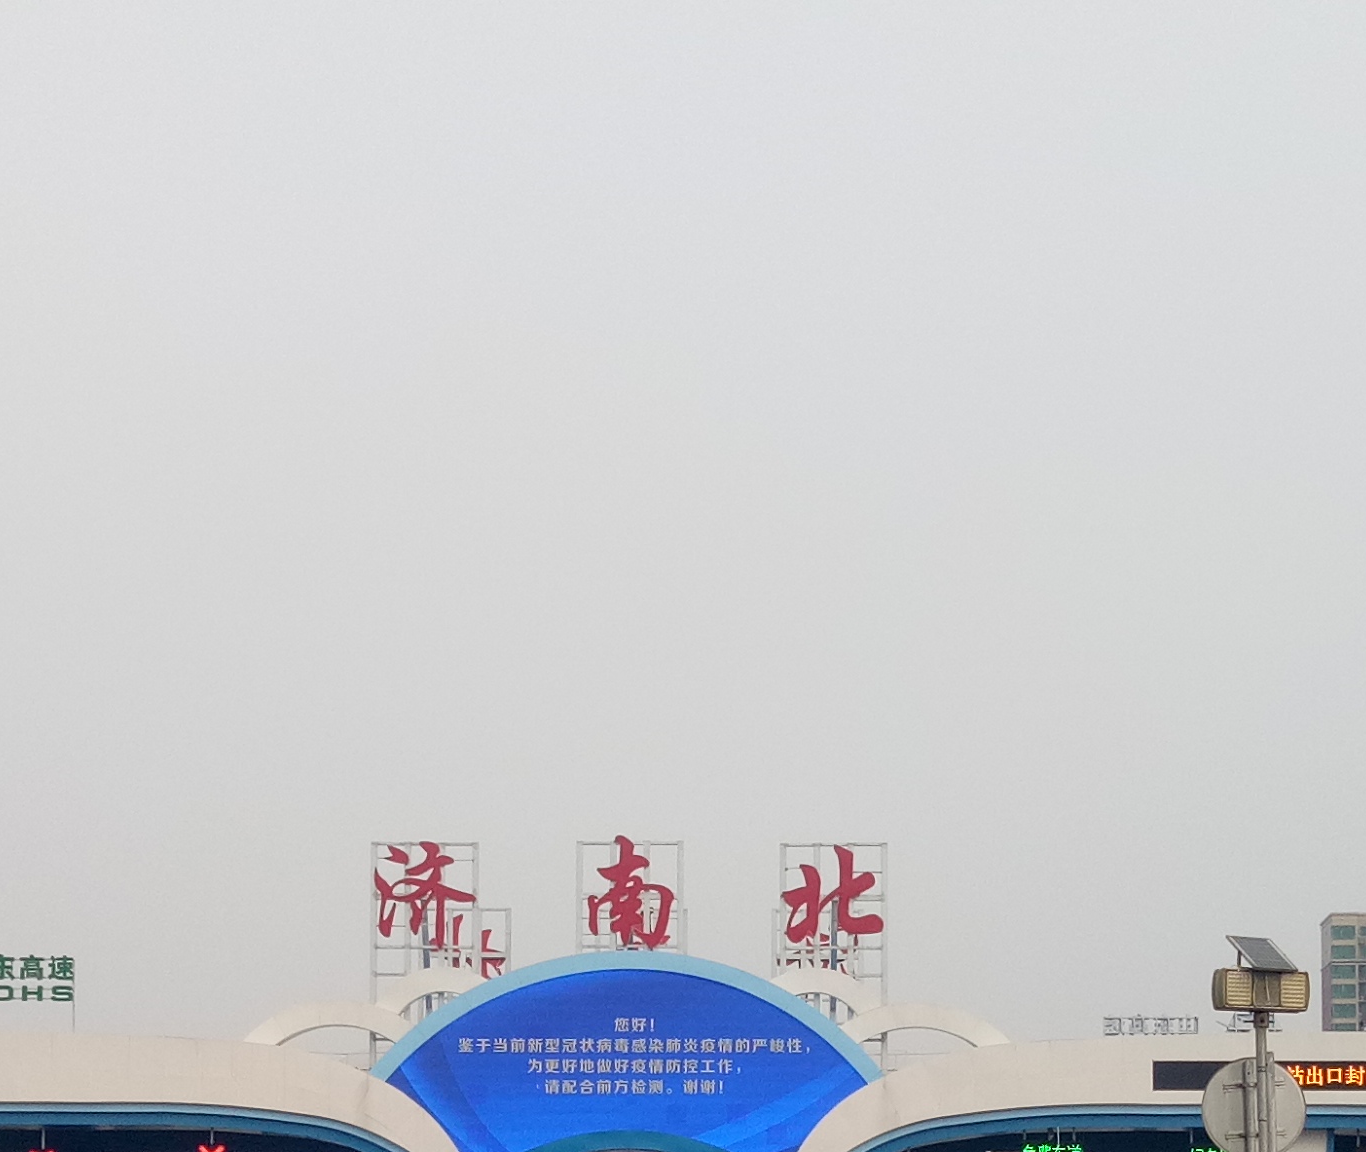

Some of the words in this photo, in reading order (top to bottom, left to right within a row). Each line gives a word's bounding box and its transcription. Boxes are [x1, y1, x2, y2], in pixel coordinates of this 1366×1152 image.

[373, 835, 885, 950] 济南北
[613, 1017, 656, 1033] 您好！
[527, 1058, 743, 1074] 为更好地做好疫情防控工作，
